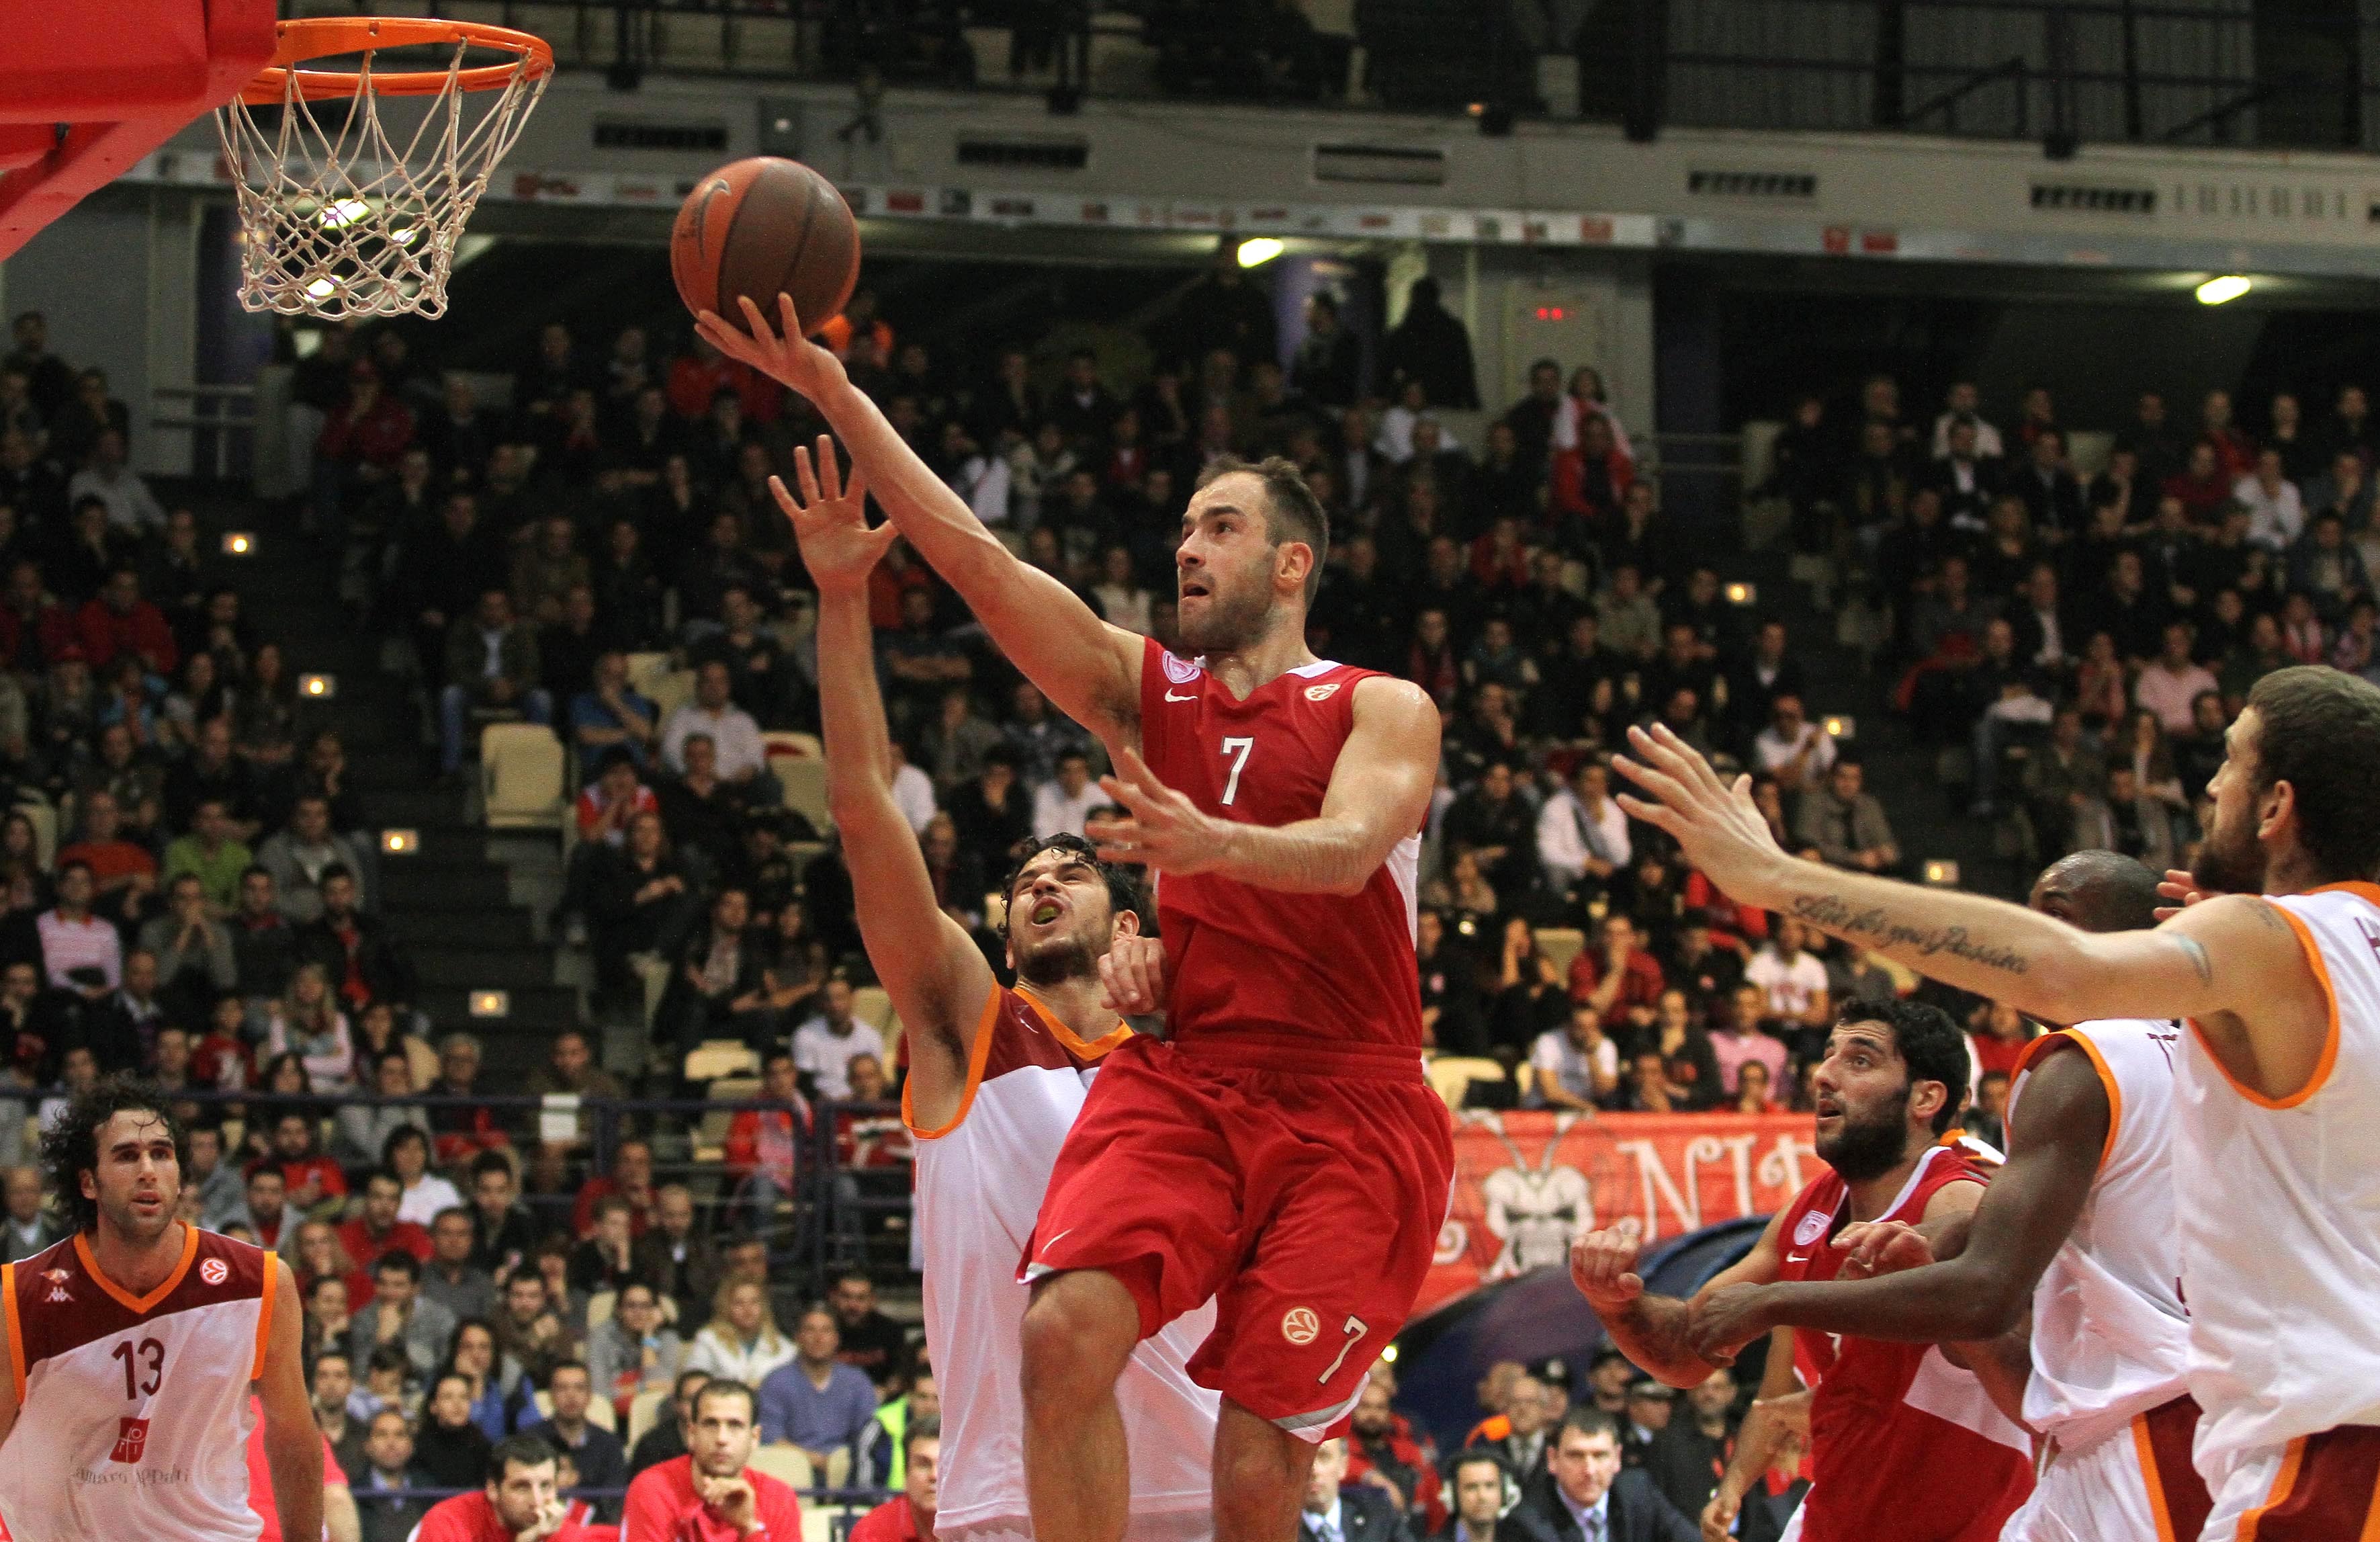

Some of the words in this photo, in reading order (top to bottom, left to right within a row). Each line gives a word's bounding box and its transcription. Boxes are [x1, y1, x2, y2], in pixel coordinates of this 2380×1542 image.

[1220, 735, 1254, 806] 7
[112, 1336, 166, 1400] 13
[1317, 1314, 1369, 1385] 7
